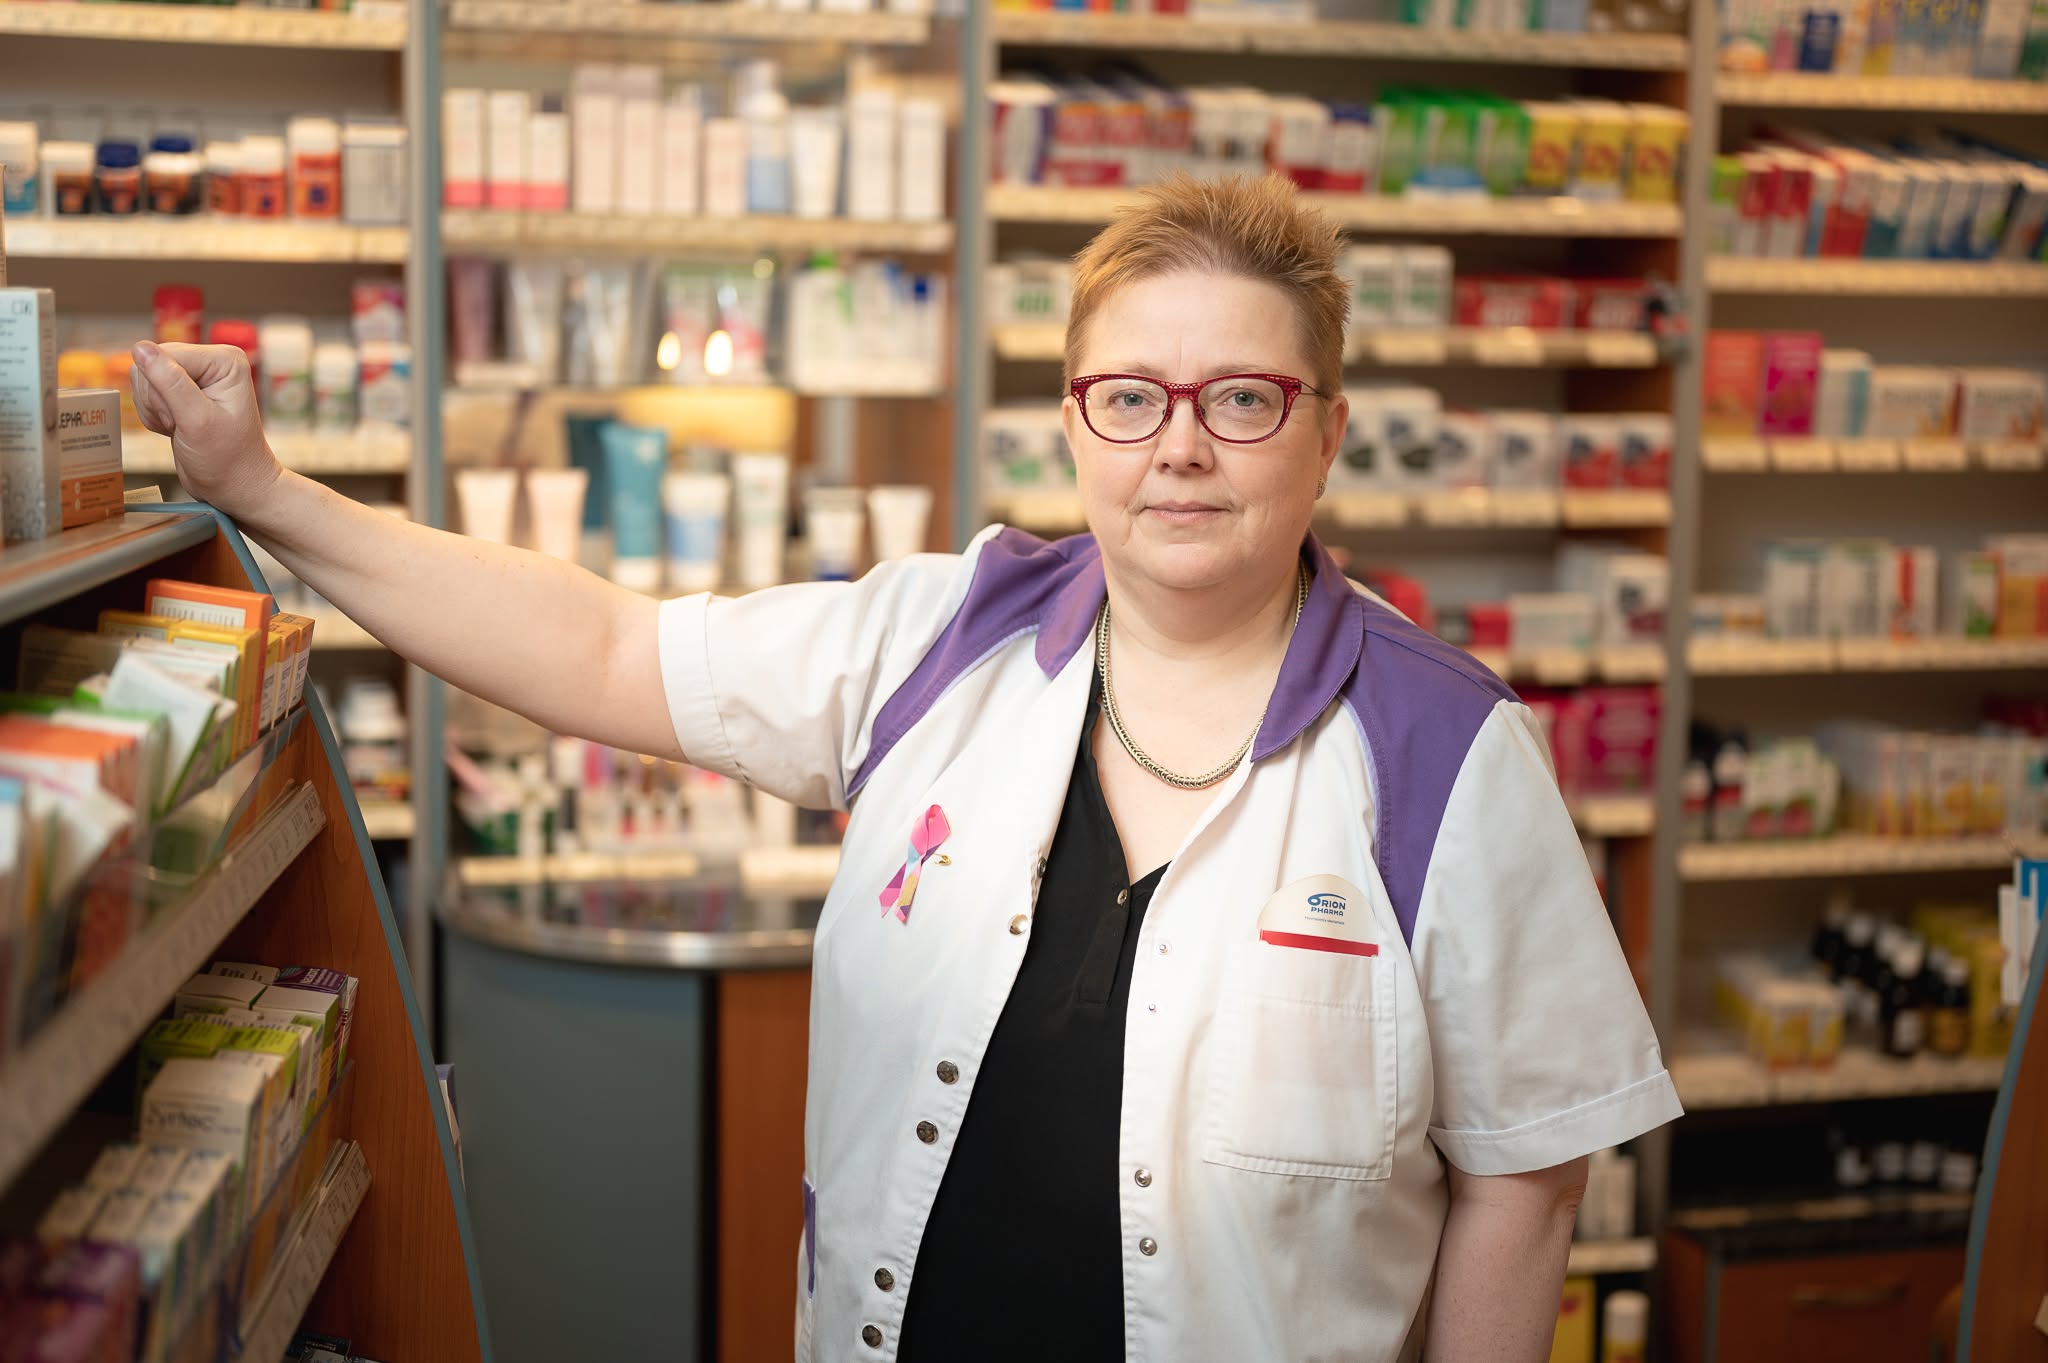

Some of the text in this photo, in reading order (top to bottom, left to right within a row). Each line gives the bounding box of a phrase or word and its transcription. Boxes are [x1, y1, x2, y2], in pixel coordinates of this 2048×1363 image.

[58, 409, 107, 429] EPHACLEAN
[1307, 893, 1347, 911] ORION
[1310, 906, 1345, 917] PHARMA
